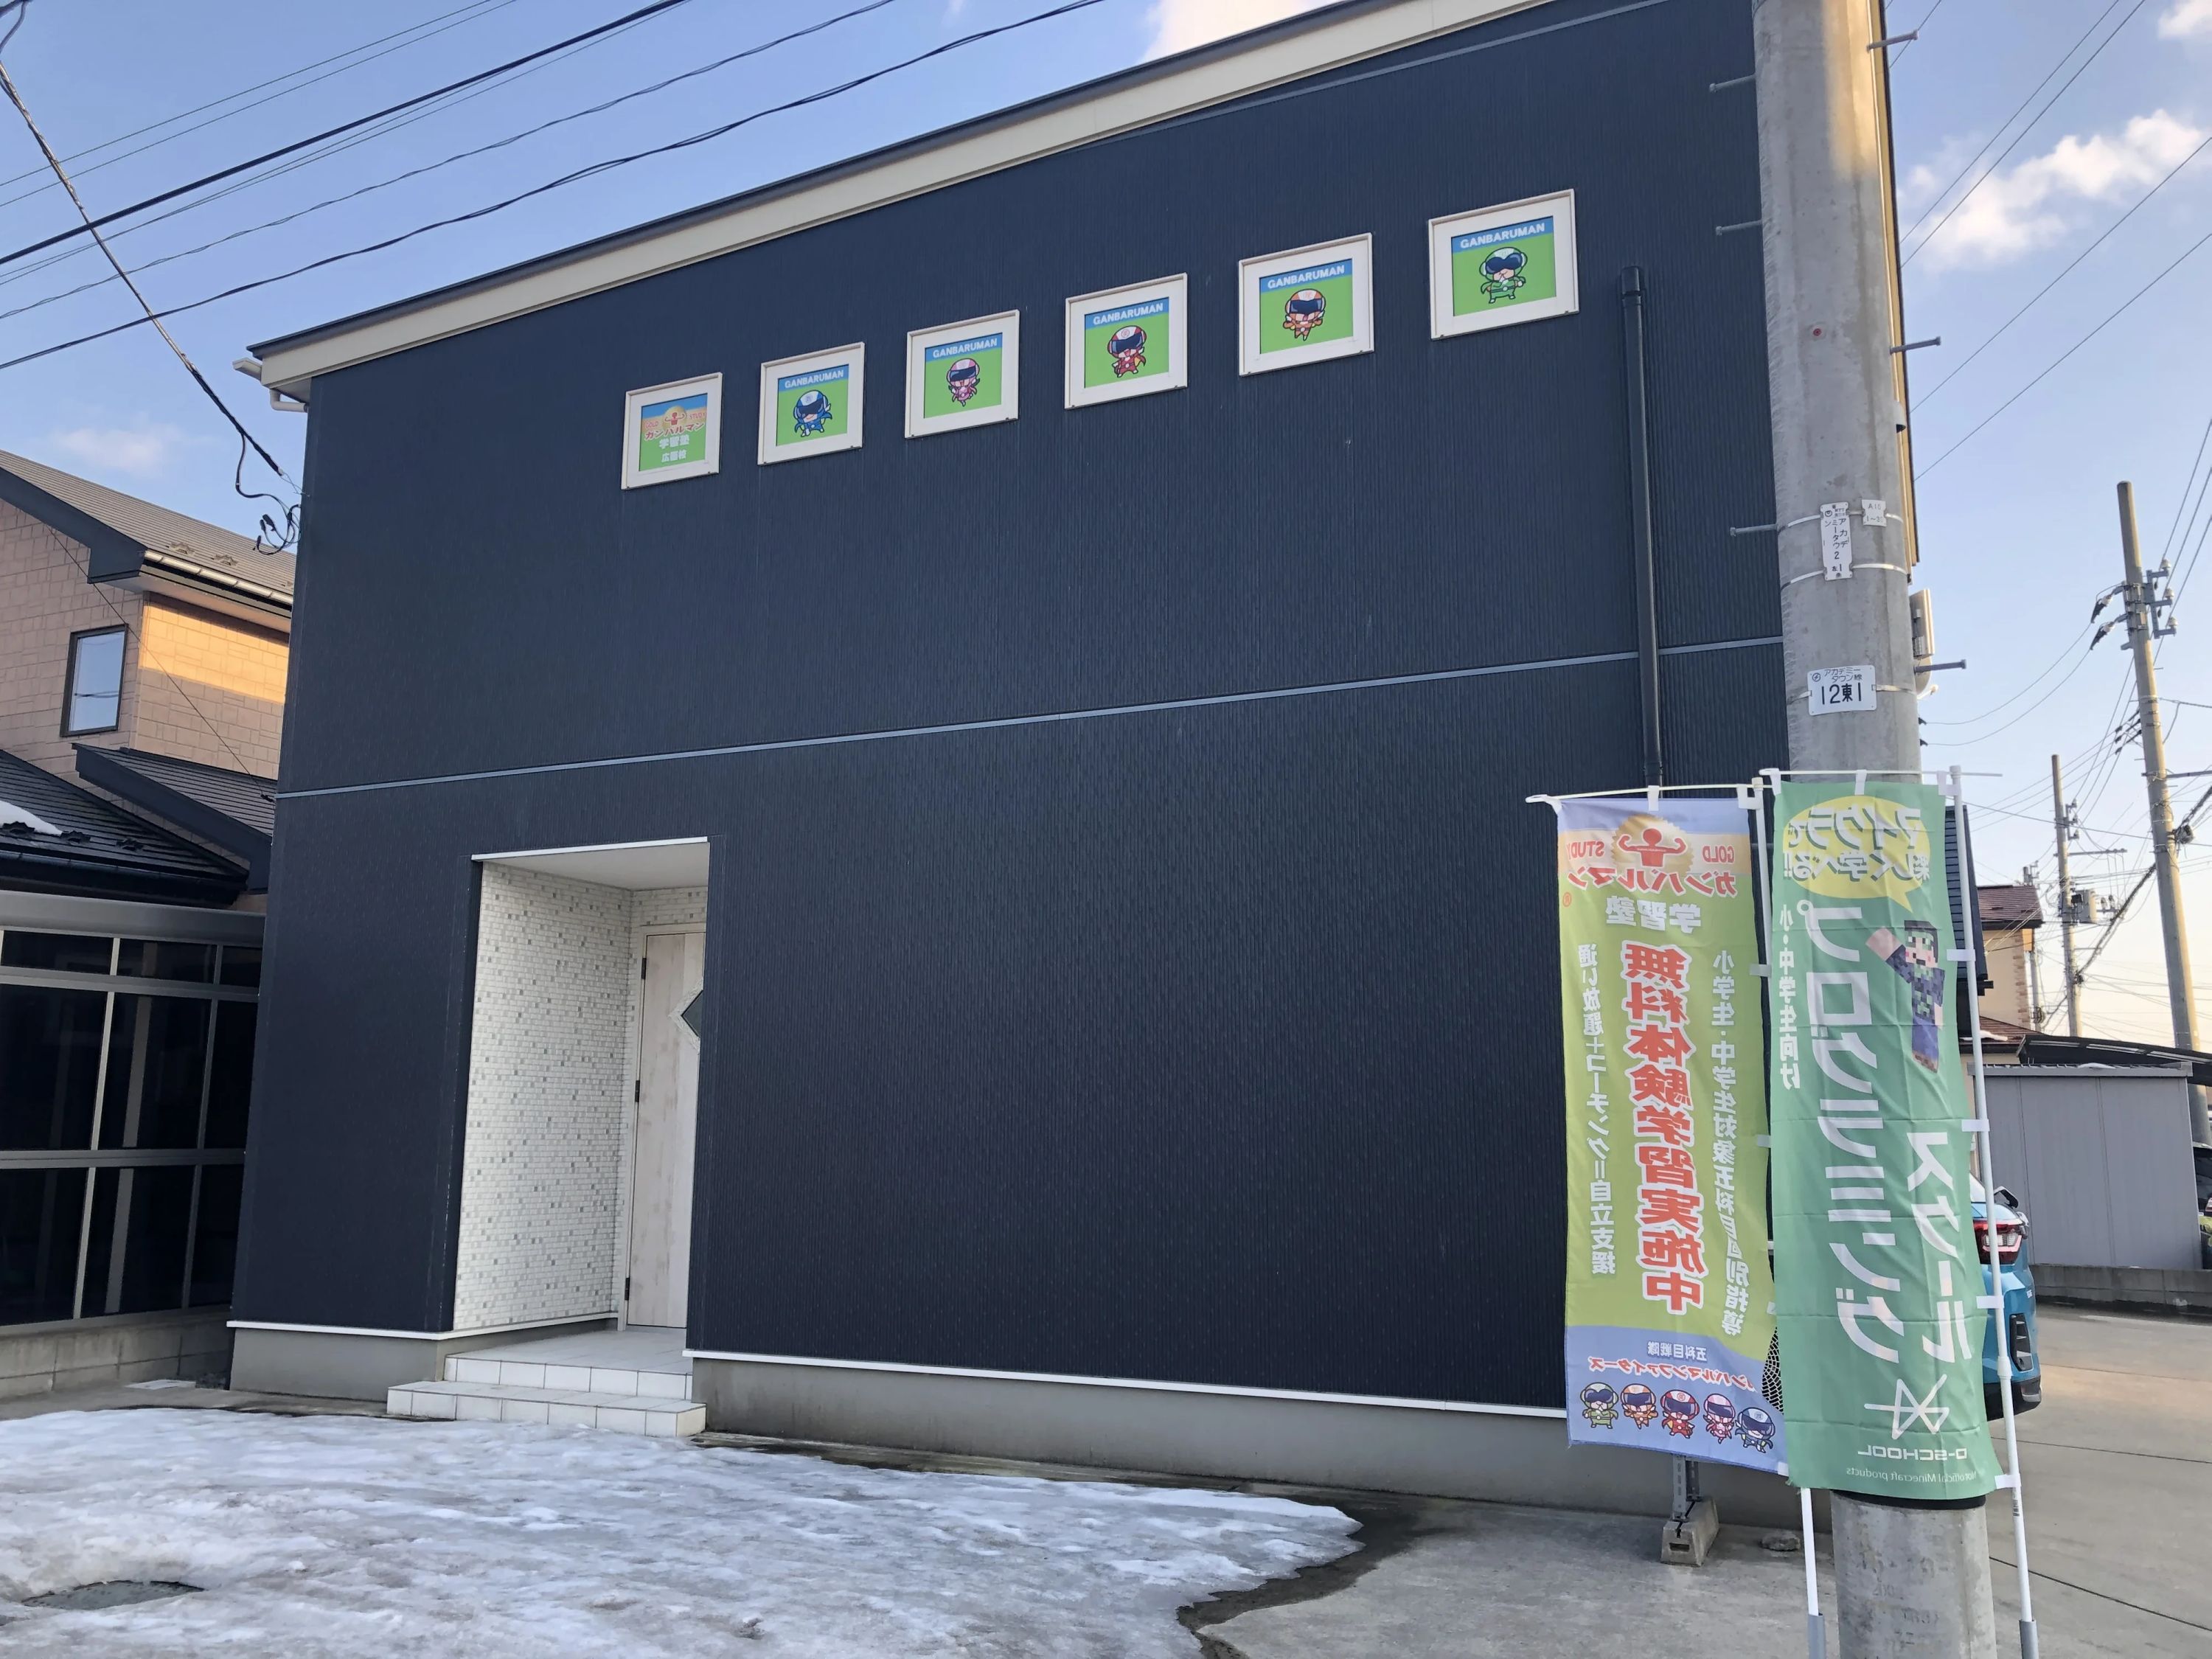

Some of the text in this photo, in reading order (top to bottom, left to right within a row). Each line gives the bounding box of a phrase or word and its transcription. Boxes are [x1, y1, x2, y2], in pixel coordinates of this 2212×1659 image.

[1461, 223, 1545, 248] GANBARUMAN
[1267, 265, 1345, 289] GANBARUMAN
[1093, 302, 1164, 324] GANBARUMAN
[933, 338, 997, 358] GANBARUMAN
[784, 370, 844, 389] GANBARUMAN
[1824, 667, 1861, 677] アカデミー
[1832, 674, 1863, 683] タウン線
[1821, 682, 1862, 705] 12東1
